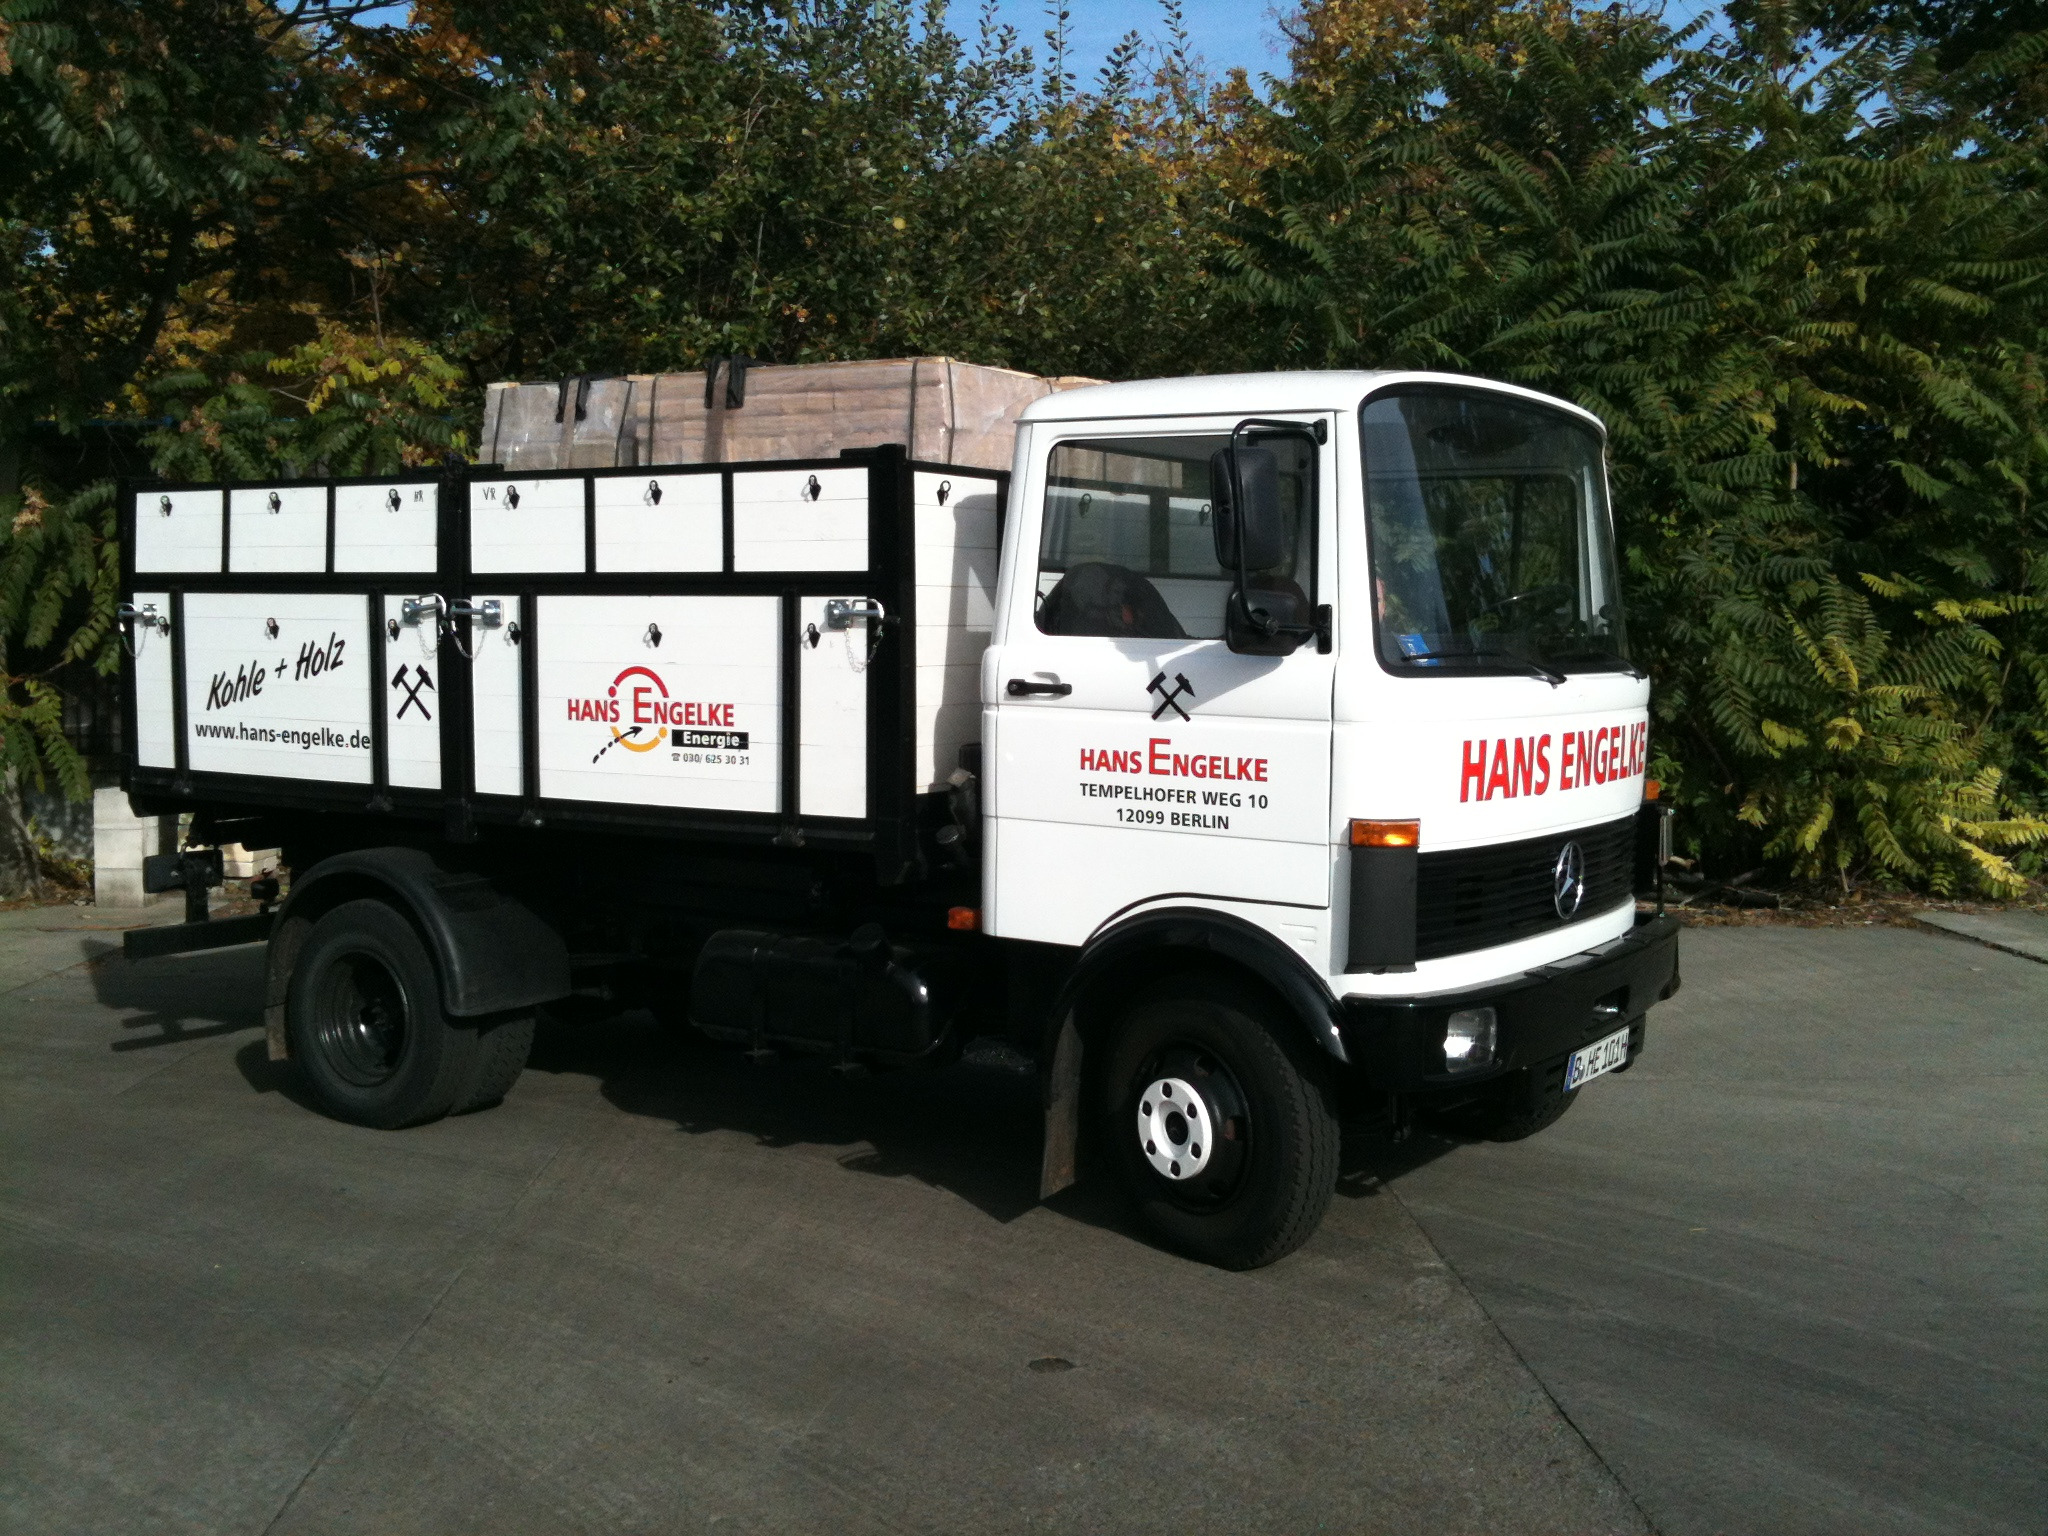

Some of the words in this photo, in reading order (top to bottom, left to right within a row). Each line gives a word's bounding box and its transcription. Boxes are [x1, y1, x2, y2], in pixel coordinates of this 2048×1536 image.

[206, 659, 266, 711] Kohle
[295, 631, 346, 681] Holz
[567, 698, 621, 723] HANS
[633, 687, 735, 727] ENGELKE
[195, 721, 371, 750] www.hans-engelke.de
[683, 731, 740, 749] Energie
[705, 753, 722, 764] 625
[725, 754, 737, 765] 30
[739, 755, 750, 766] 31
[1080, 748, 1142, 774] HANS
[1148, 737, 1268, 782] ENGELKE
[1459, 733, 1551, 803] HANS
[1559, 721, 1646, 791] ENGELKE
[1080, 782, 1197, 804] TEMPELHOFER
[1202, 790, 1242, 808] WEG
[1248, 794, 1269, 809] 10
[1116, 808, 1165, 825] 12099
[1170, 812, 1230, 830] BERLIN
